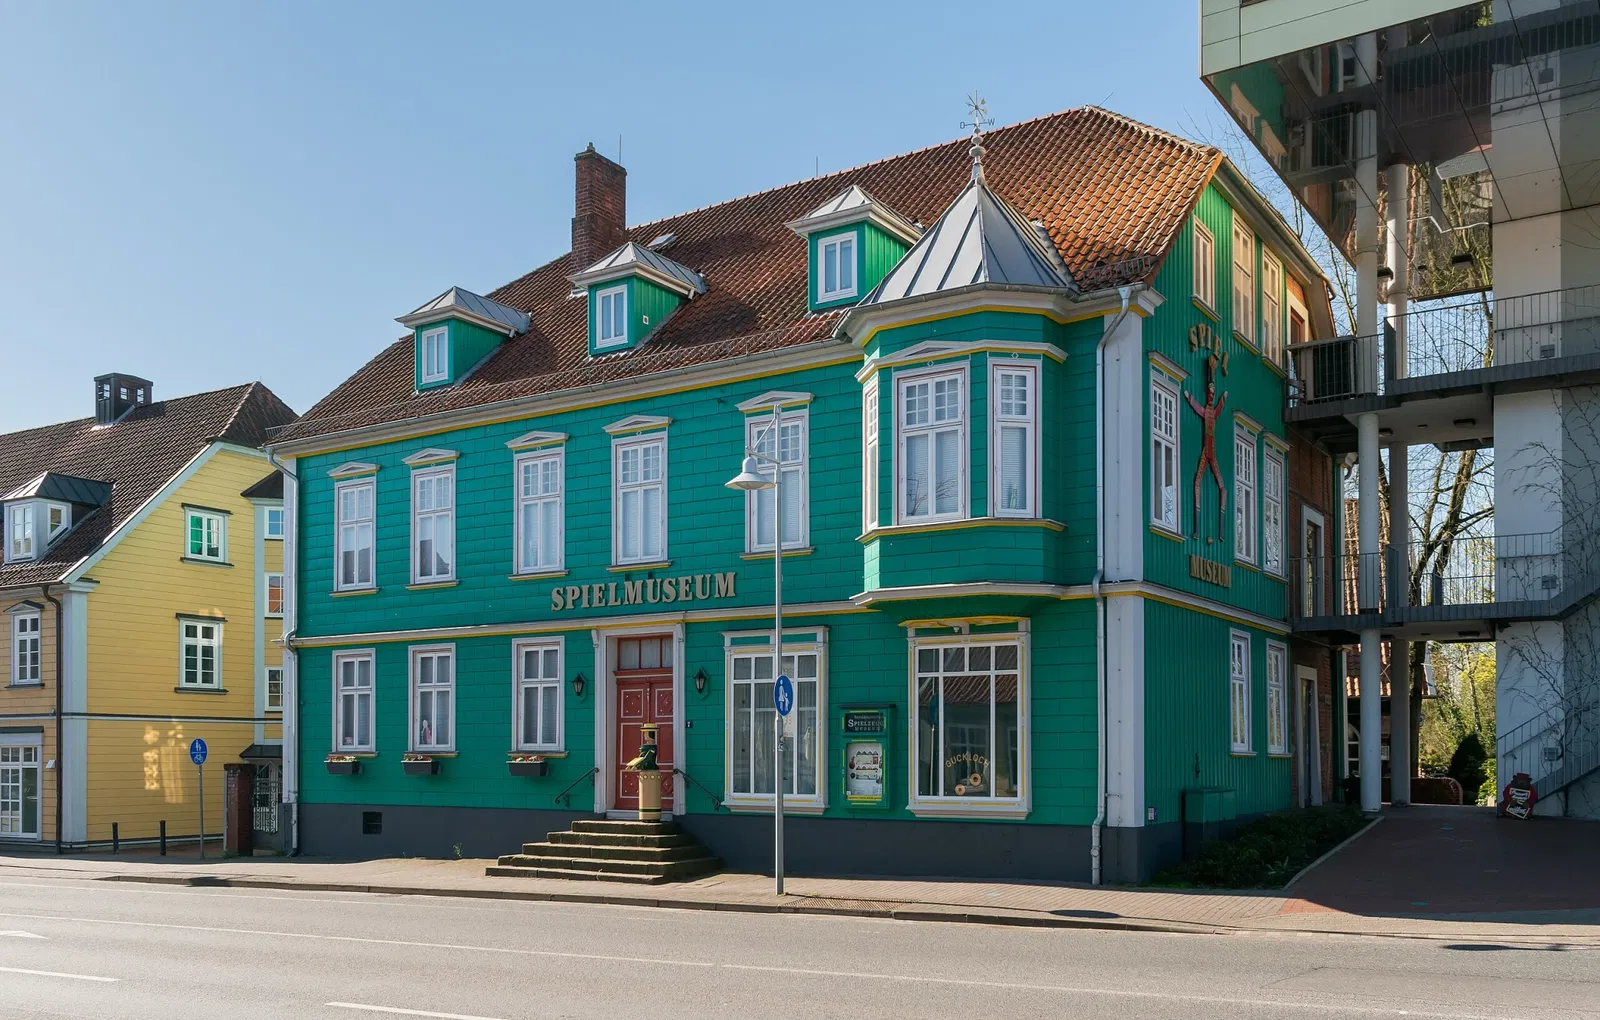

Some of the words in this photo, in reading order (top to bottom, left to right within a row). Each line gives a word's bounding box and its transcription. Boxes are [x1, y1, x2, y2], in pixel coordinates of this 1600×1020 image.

[1190, 554, 1231, 588] MUSEUM
[551, 571, 736, 611] SPIELMUSEUM
[945, 752, 990, 768] GUCKLOCH
